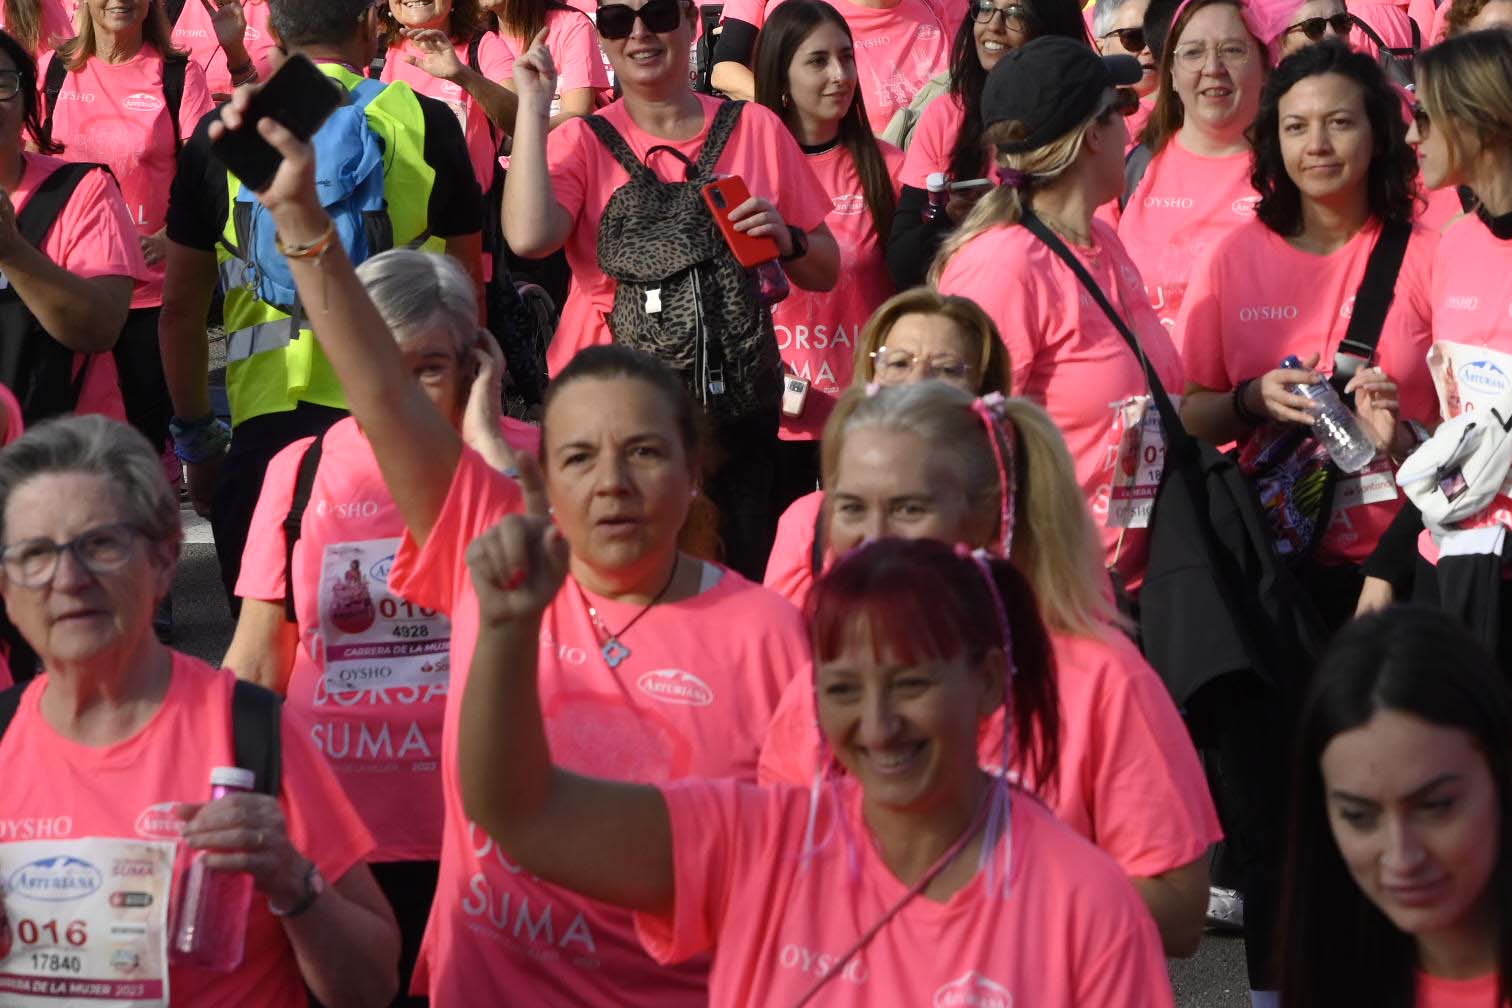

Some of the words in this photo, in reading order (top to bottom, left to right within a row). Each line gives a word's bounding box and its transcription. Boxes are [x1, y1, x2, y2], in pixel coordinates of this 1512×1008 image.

[1143, 196, 1194, 209] OYSHO
[1239, 305, 1298, 321] OYSHO
[392, 624, 429, 639] 4928
[343, 645, 391, 657] CARRERA
[393, 644, 408, 656] DE
[409, 642, 423, 654] LA
[339, 665, 393, 683] OYSHO
[311, 719, 433, 760] SUMA
[462, 873, 597, 953] SUMA
[18, 917, 88, 947] 016
[31, 953, 82, 974] 17840
